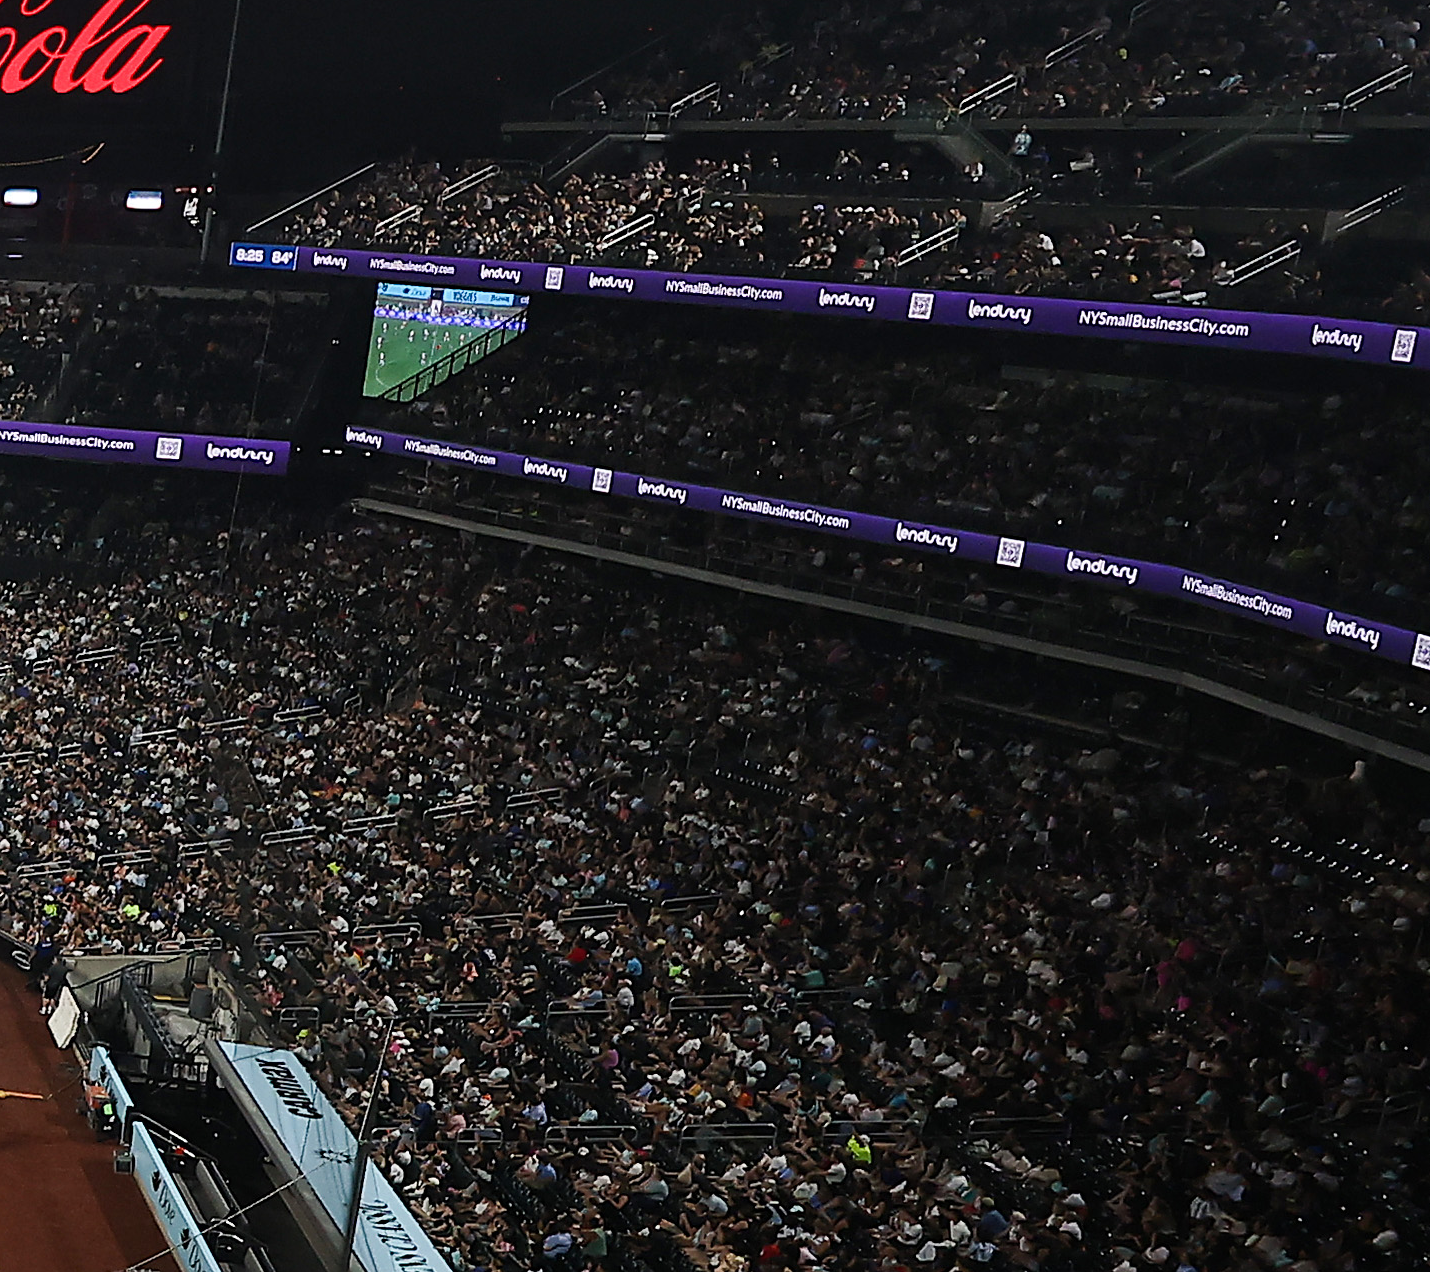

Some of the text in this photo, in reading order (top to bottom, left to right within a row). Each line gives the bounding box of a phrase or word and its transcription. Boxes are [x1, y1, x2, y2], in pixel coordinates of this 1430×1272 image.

[1078, 310, 1250, 338] NYSmallBusinessCity.com
[206, 442, 275, 465] lendistry
[896, 521, 1381, 652] lendistry lendistry NYSmallBusinessCity.com lendistry
